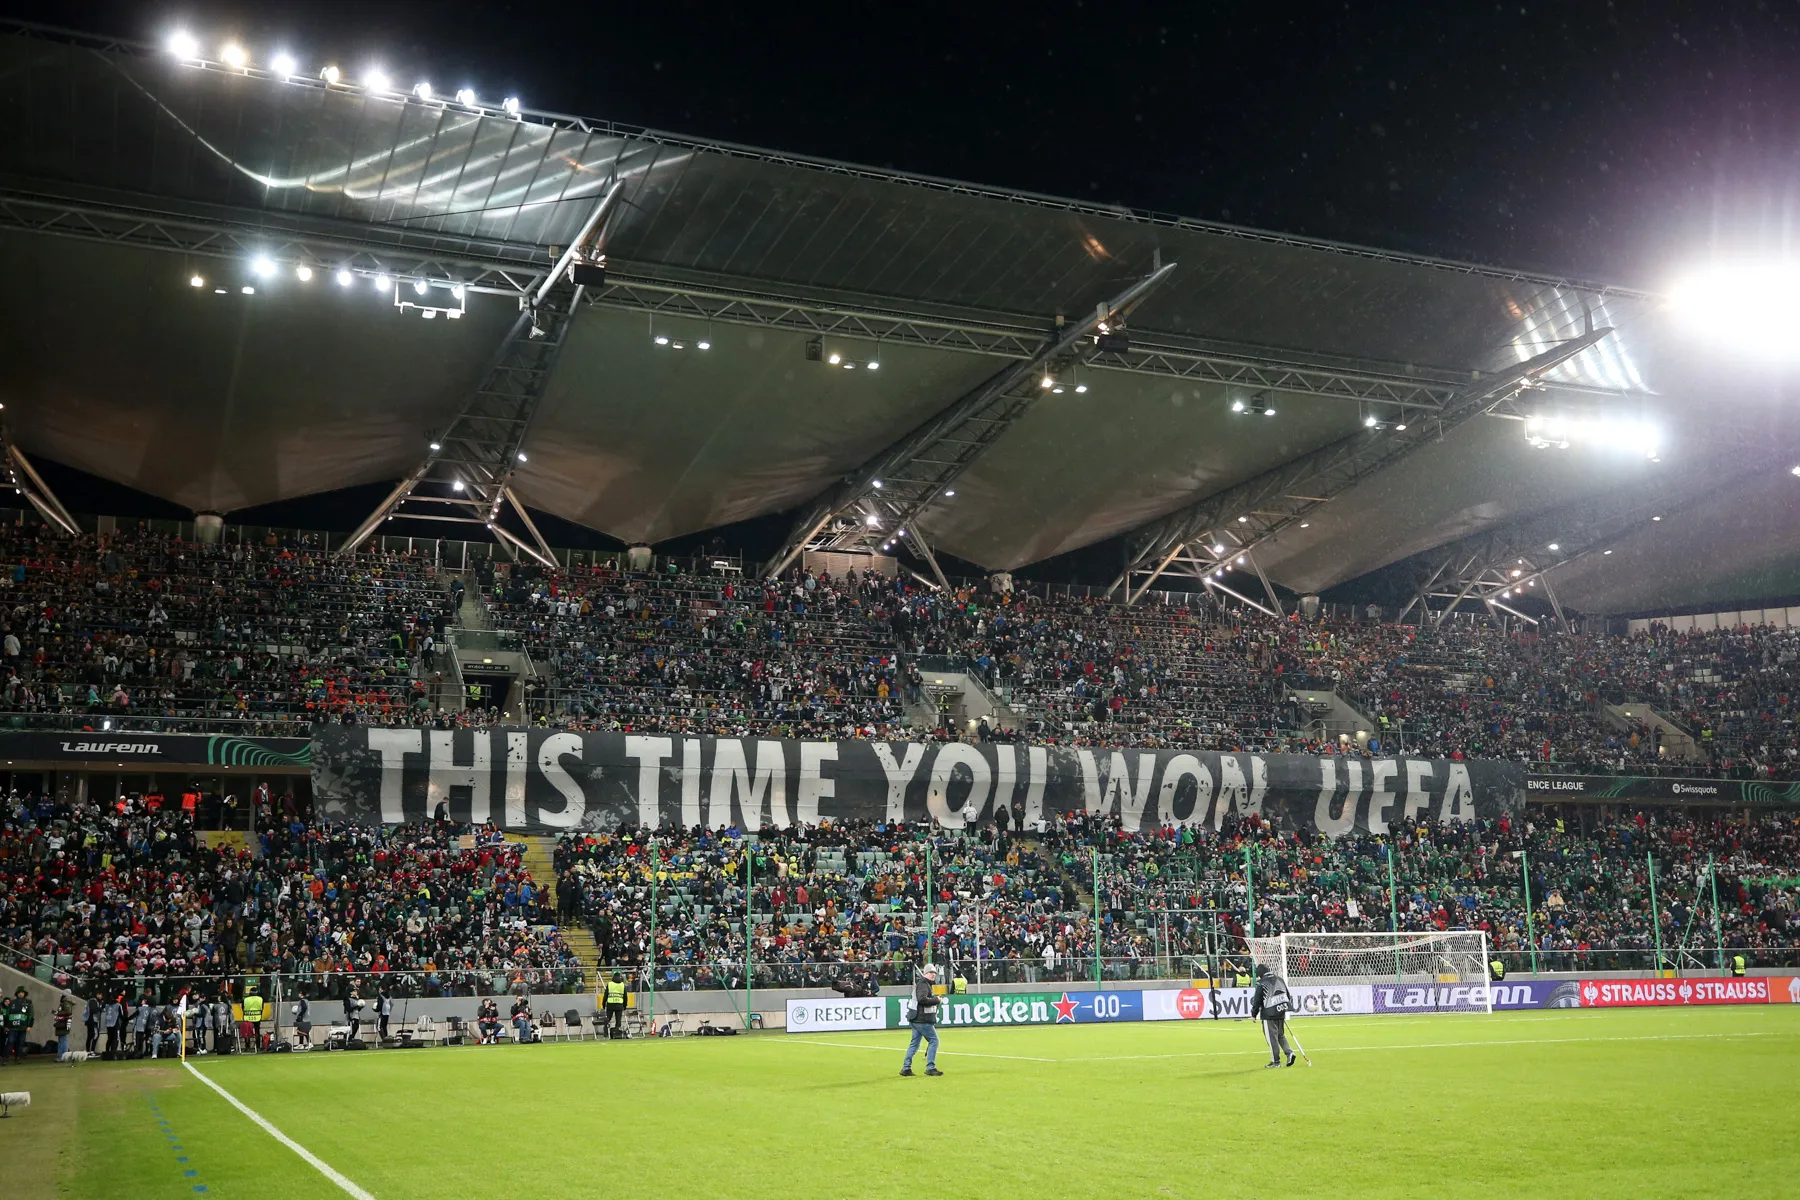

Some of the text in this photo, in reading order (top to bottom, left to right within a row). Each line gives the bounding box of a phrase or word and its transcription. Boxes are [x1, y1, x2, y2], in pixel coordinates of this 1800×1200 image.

[368, 728, 1476, 838] THIS TIME YOU WON UEFA
[1527, 780, 1584, 790] ENCE LEAGUE
[1680, 784, 1718, 794] Swissquote
[1602, 982, 1766, 1001] STRAUSS STRAUSS
[898, 997, 1049, 1026] ineken
[1094, 995, 1119, 1018] 0.0
[1209, 988, 1342, 1016] Swiuote
[815, 1006, 881, 1021] RESPECT
